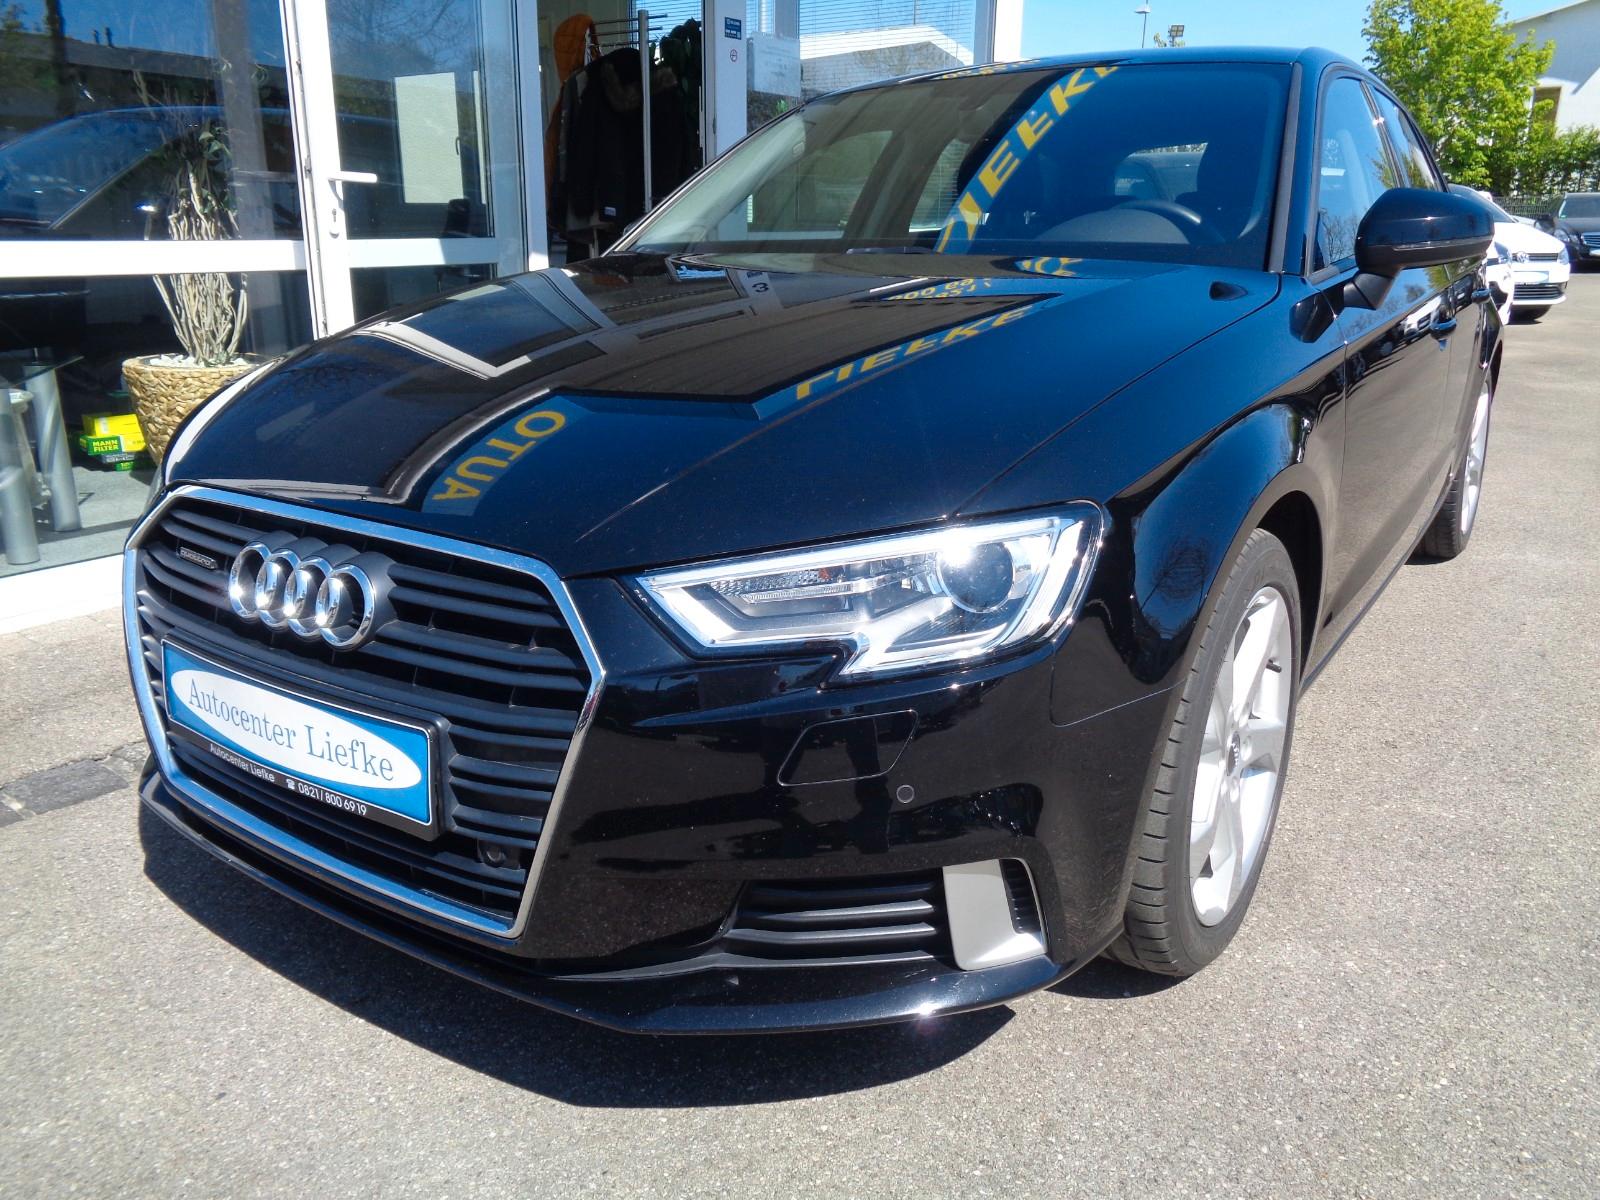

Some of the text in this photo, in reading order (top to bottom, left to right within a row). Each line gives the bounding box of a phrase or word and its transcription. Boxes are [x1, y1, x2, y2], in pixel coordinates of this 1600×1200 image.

[92, 440, 118, 448] MANN
[93, 444, 119, 453] FILTER
[188, 678, 394, 781] Autocenter Liefke
[209, 743, 250, 771] Autocenter
[250, 763, 276, 783] Liefke
